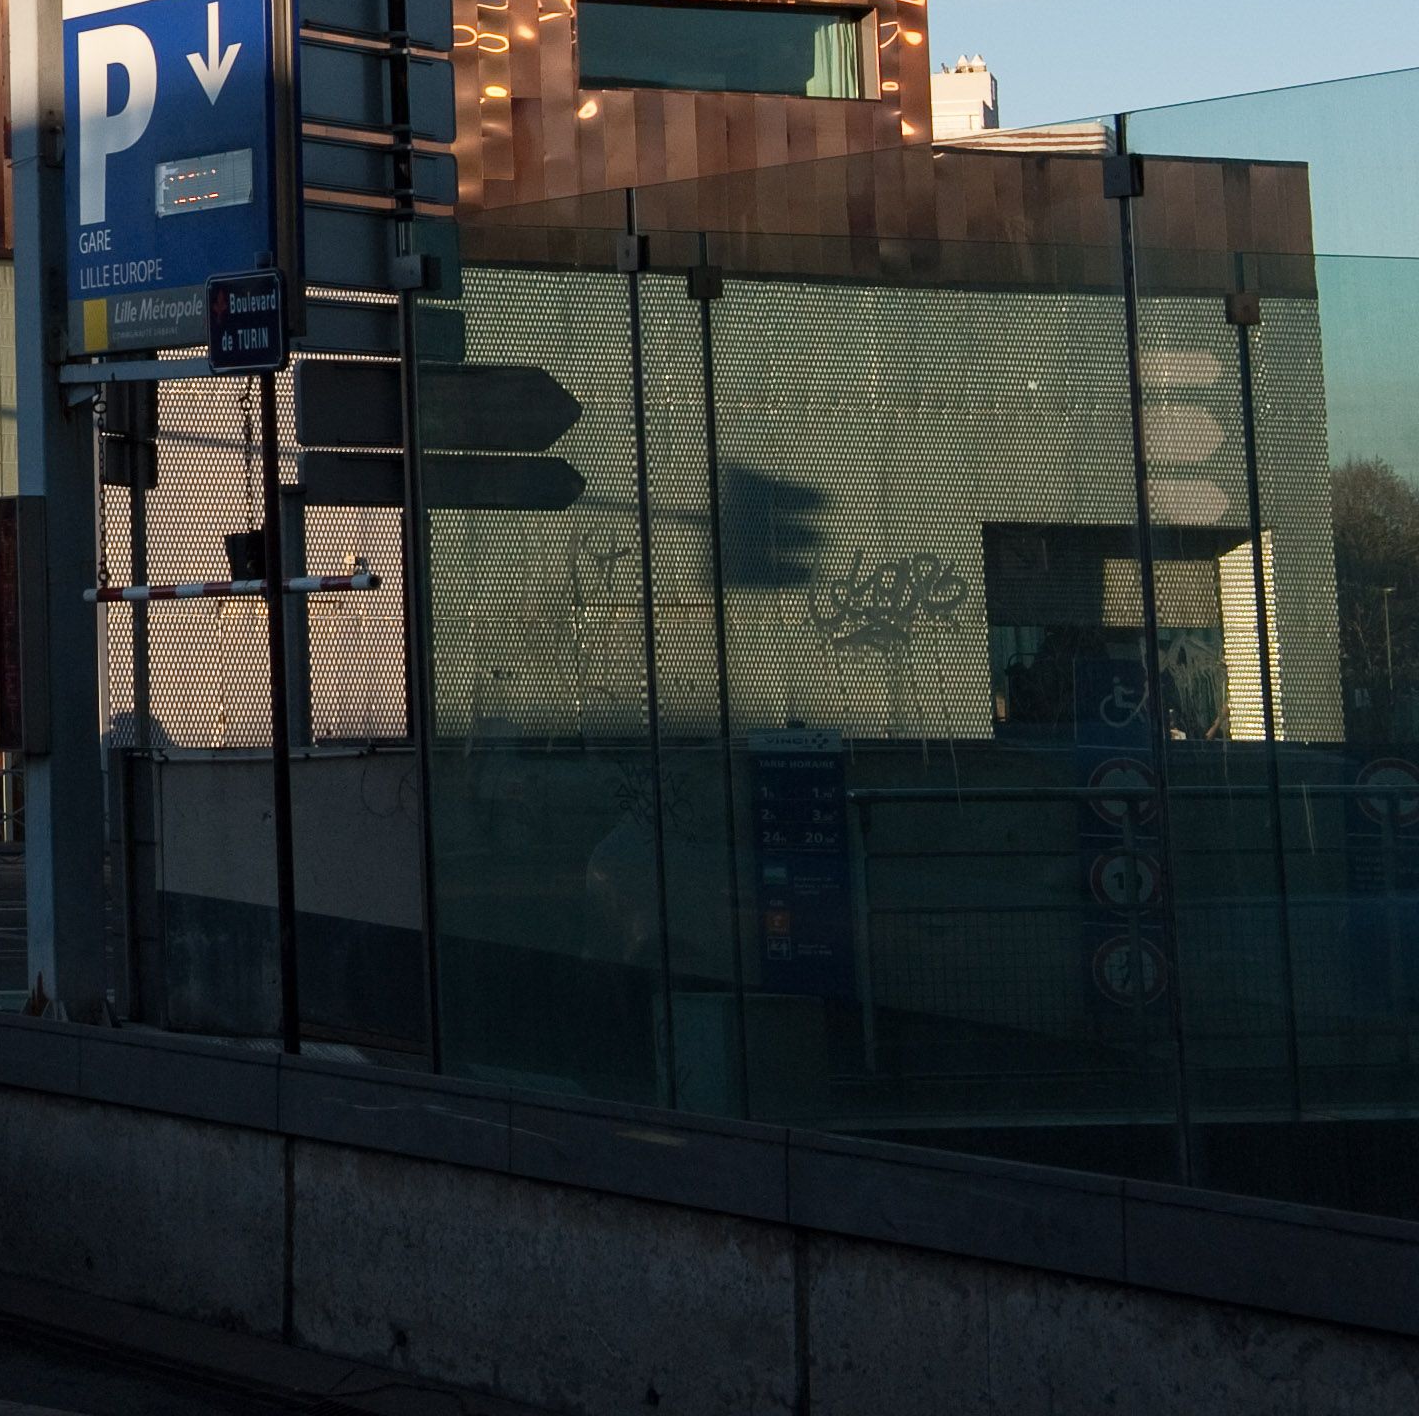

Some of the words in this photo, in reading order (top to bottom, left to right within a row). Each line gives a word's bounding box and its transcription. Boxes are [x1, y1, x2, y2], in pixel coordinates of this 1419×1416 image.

[78, 24, 157, 225] P
[79, 229, 112, 254] GARE
[80, 264, 110, 290] LILLE
[113, 258, 163, 285] EUROPE
[114, 300, 137, 323] Lille
[139, 293, 203, 324] Métropole
[229, 289, 276, 314] Boulevard
[221, 327, 234, 351] de
[238, 327, 270, 350] TURIN
[764, 736, 808, 744] VINCI
